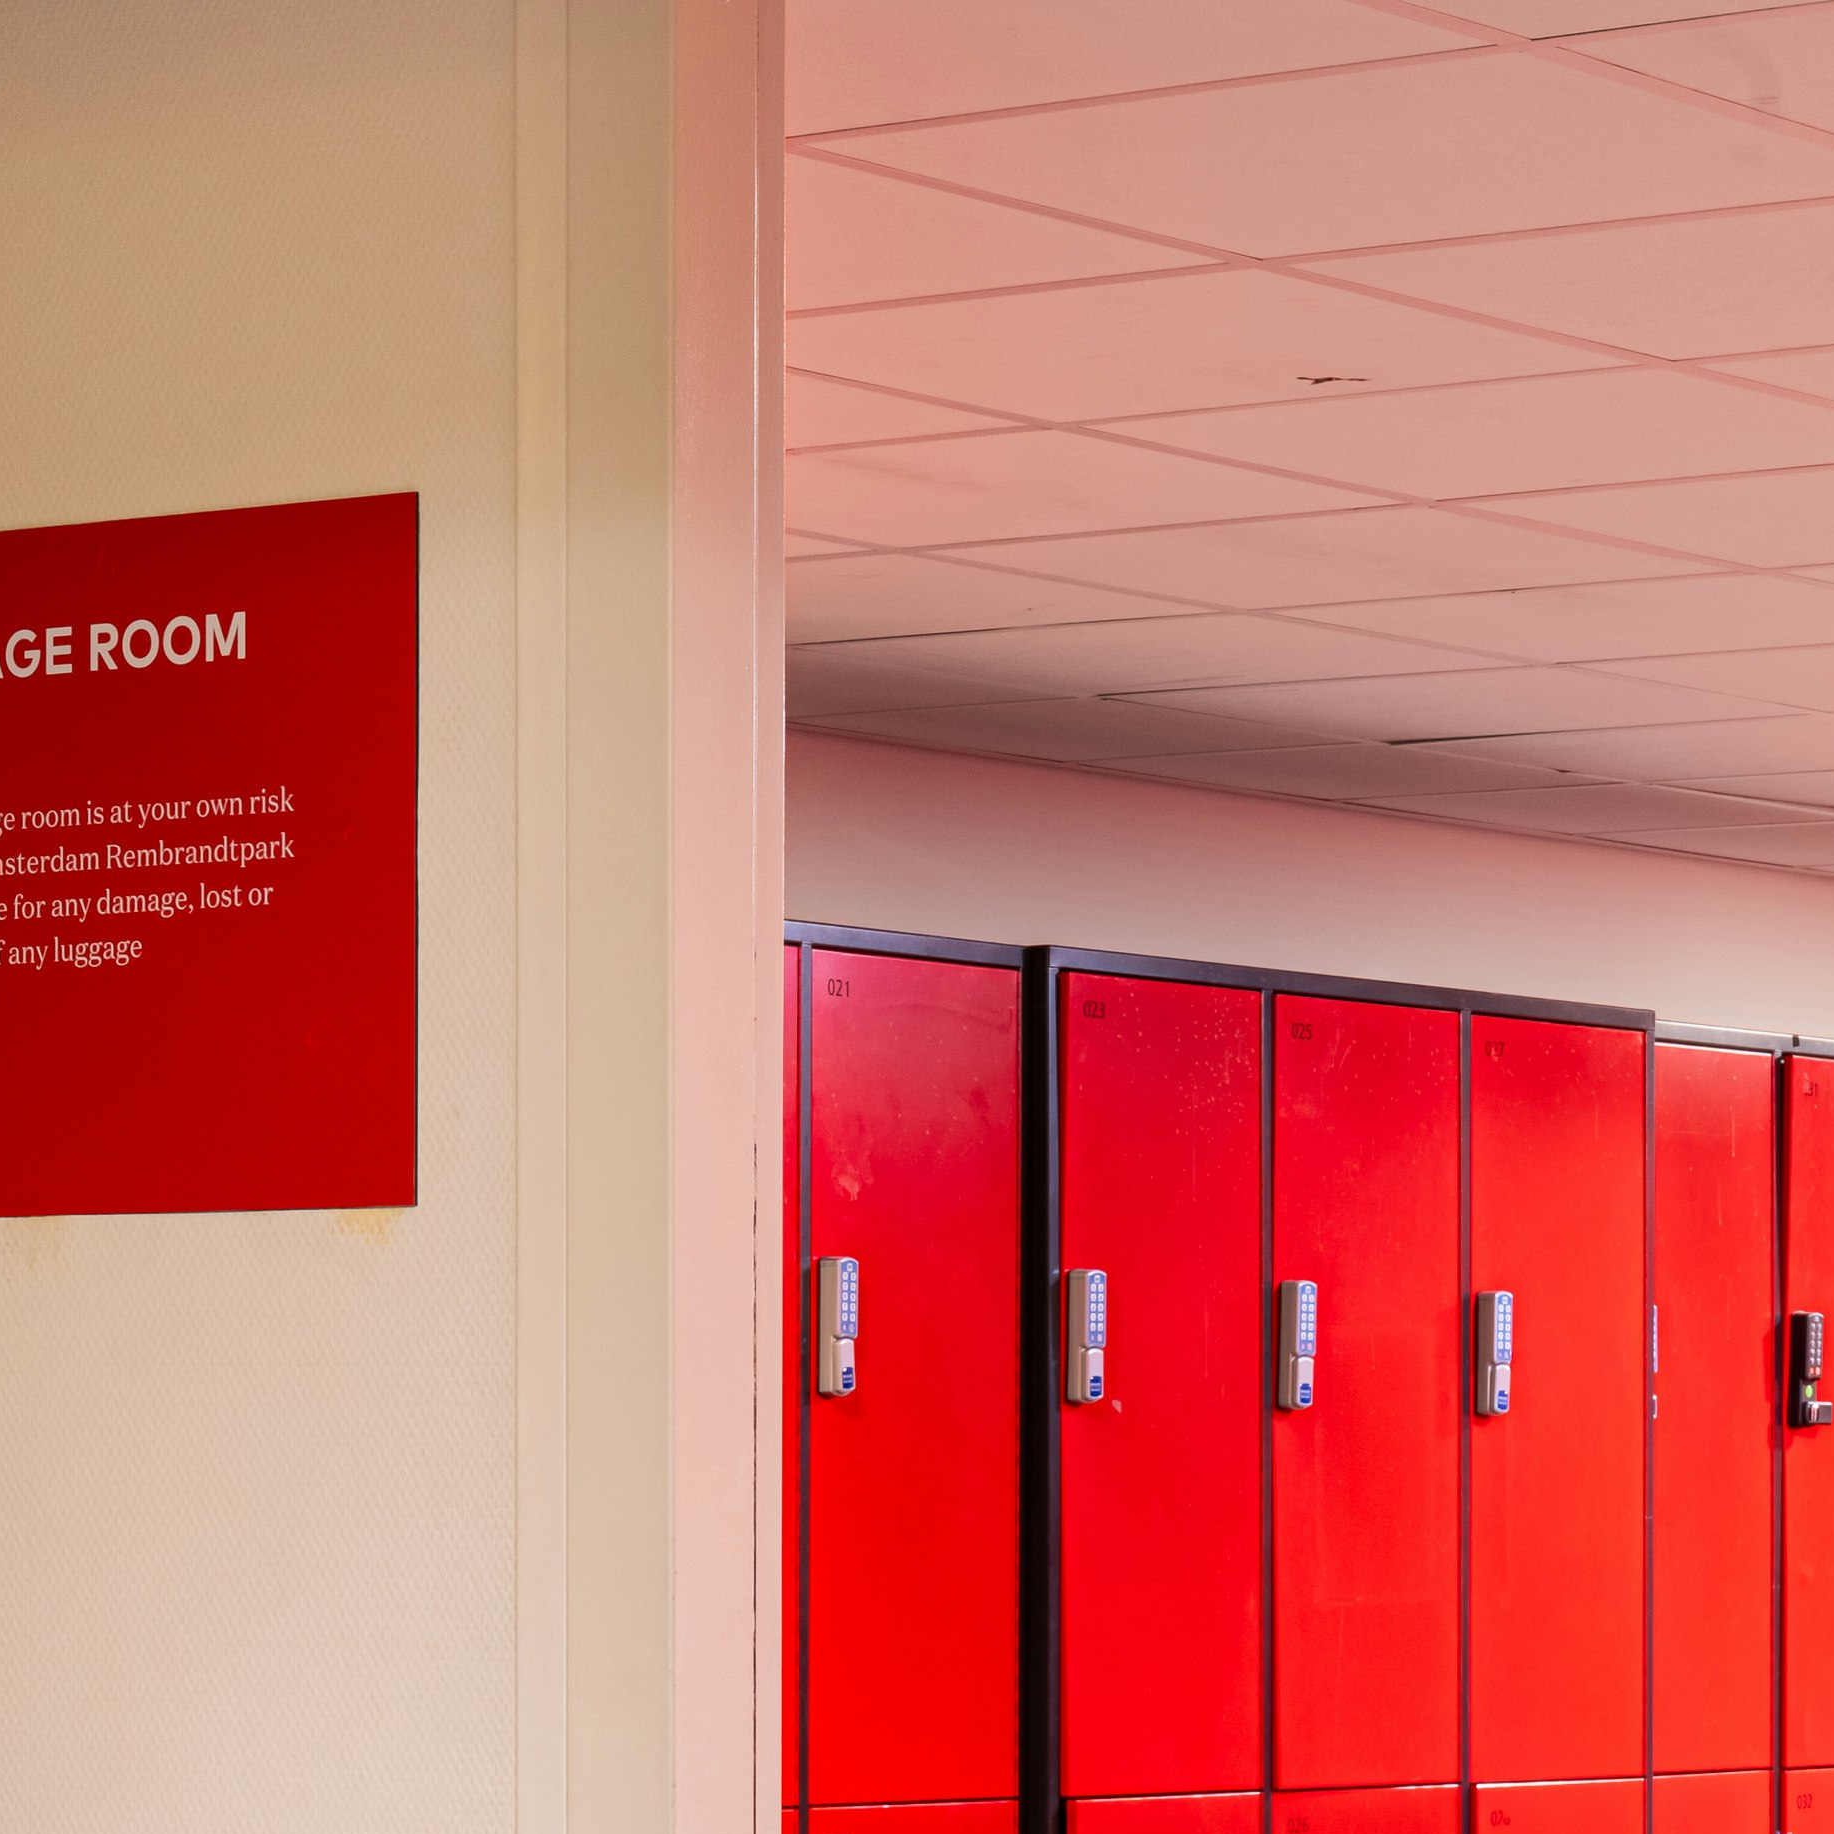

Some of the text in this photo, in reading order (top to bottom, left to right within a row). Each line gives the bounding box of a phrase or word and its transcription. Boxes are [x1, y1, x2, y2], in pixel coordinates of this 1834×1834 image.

[90, 612, 245, 671] ROOM
[22, 809, 80, 829] room
[87, 801, 104, 824] is
[110, 801, 132, 823] at
[138, 801, 191, 828] your
[197, 798, 243, 817] own
[250, 786, 294, 814] risk
[107, 832, 294, 869] Rembrandtpark
[14, 894, 46, 919] for
[52, 898, 91, 922] any
[97, 889, 193, 918] damage,
[200, 883, 242, 908] lost
[248, 887, 273, 906] or
[9, 946, 48, 970] any
[54, 937, 142, 968] luggage
[827, 979, 849, 998] 021
[1082, 1000, 1106, 1019] 023
[1291, 1022, 1313, 1040] 025
[1796, 1794, 1813, 1809] 032
